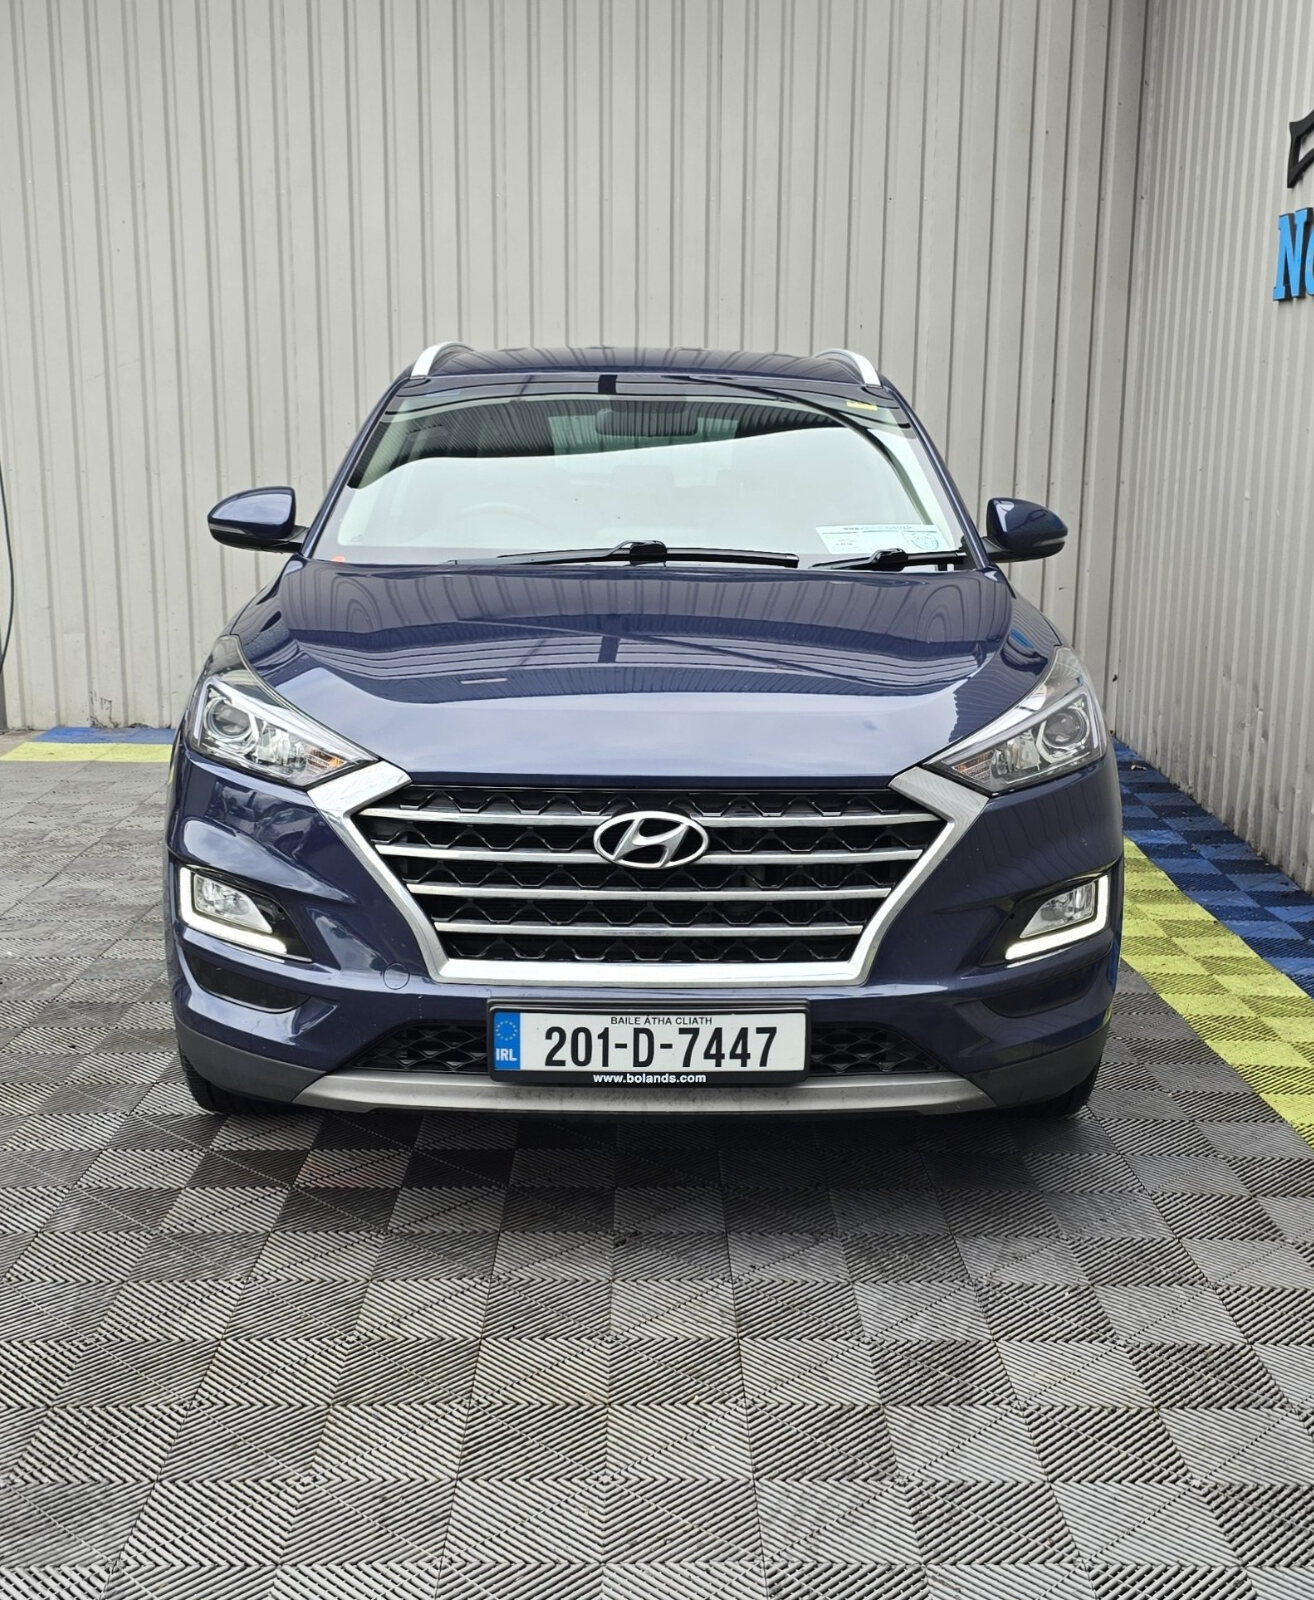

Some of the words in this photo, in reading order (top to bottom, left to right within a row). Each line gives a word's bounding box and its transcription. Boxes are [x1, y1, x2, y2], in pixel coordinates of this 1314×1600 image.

[610, 1016, 641, 1025] BAILE
[675, 1016, 713, 1025] CLIATH
[544, 1026, 778, 1068] 201-D-7447
[495, 1048, 517, 1061] IRL
[592, 1073, 707, 1084] www.bolands.com
